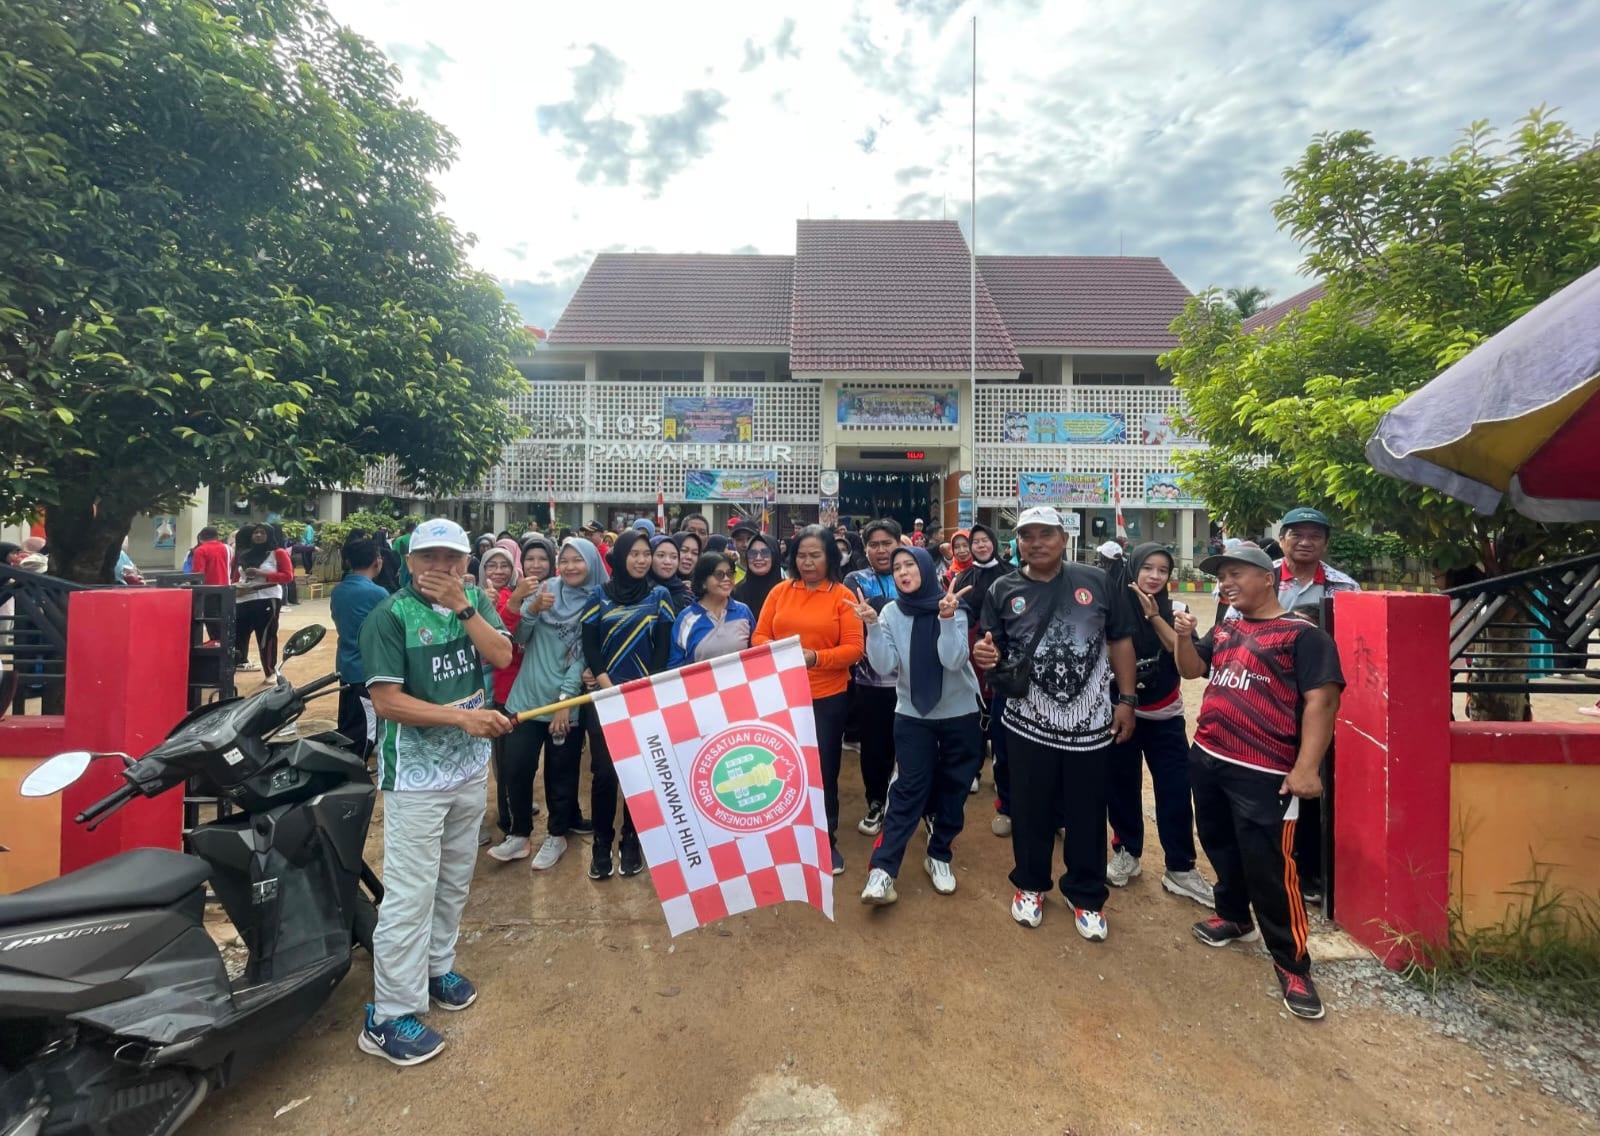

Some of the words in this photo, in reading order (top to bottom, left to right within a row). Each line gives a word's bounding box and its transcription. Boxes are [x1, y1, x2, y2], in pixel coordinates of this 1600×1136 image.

[616, 414, 662, 437] 05
[715, 444, 793, 463] HILIR
[698, 732, 751, 774] PERSATUAN
[753, 733, 784, 751] GURU
[646, 734, 688, 826] MEMPAWAH
[678, 827, 702, 869] HILIR
[698, 780, 714, 807] PGRI
[763, 786, 797, 819] REPUBLIK
[714, 808, 763, 826] INDONESIA
